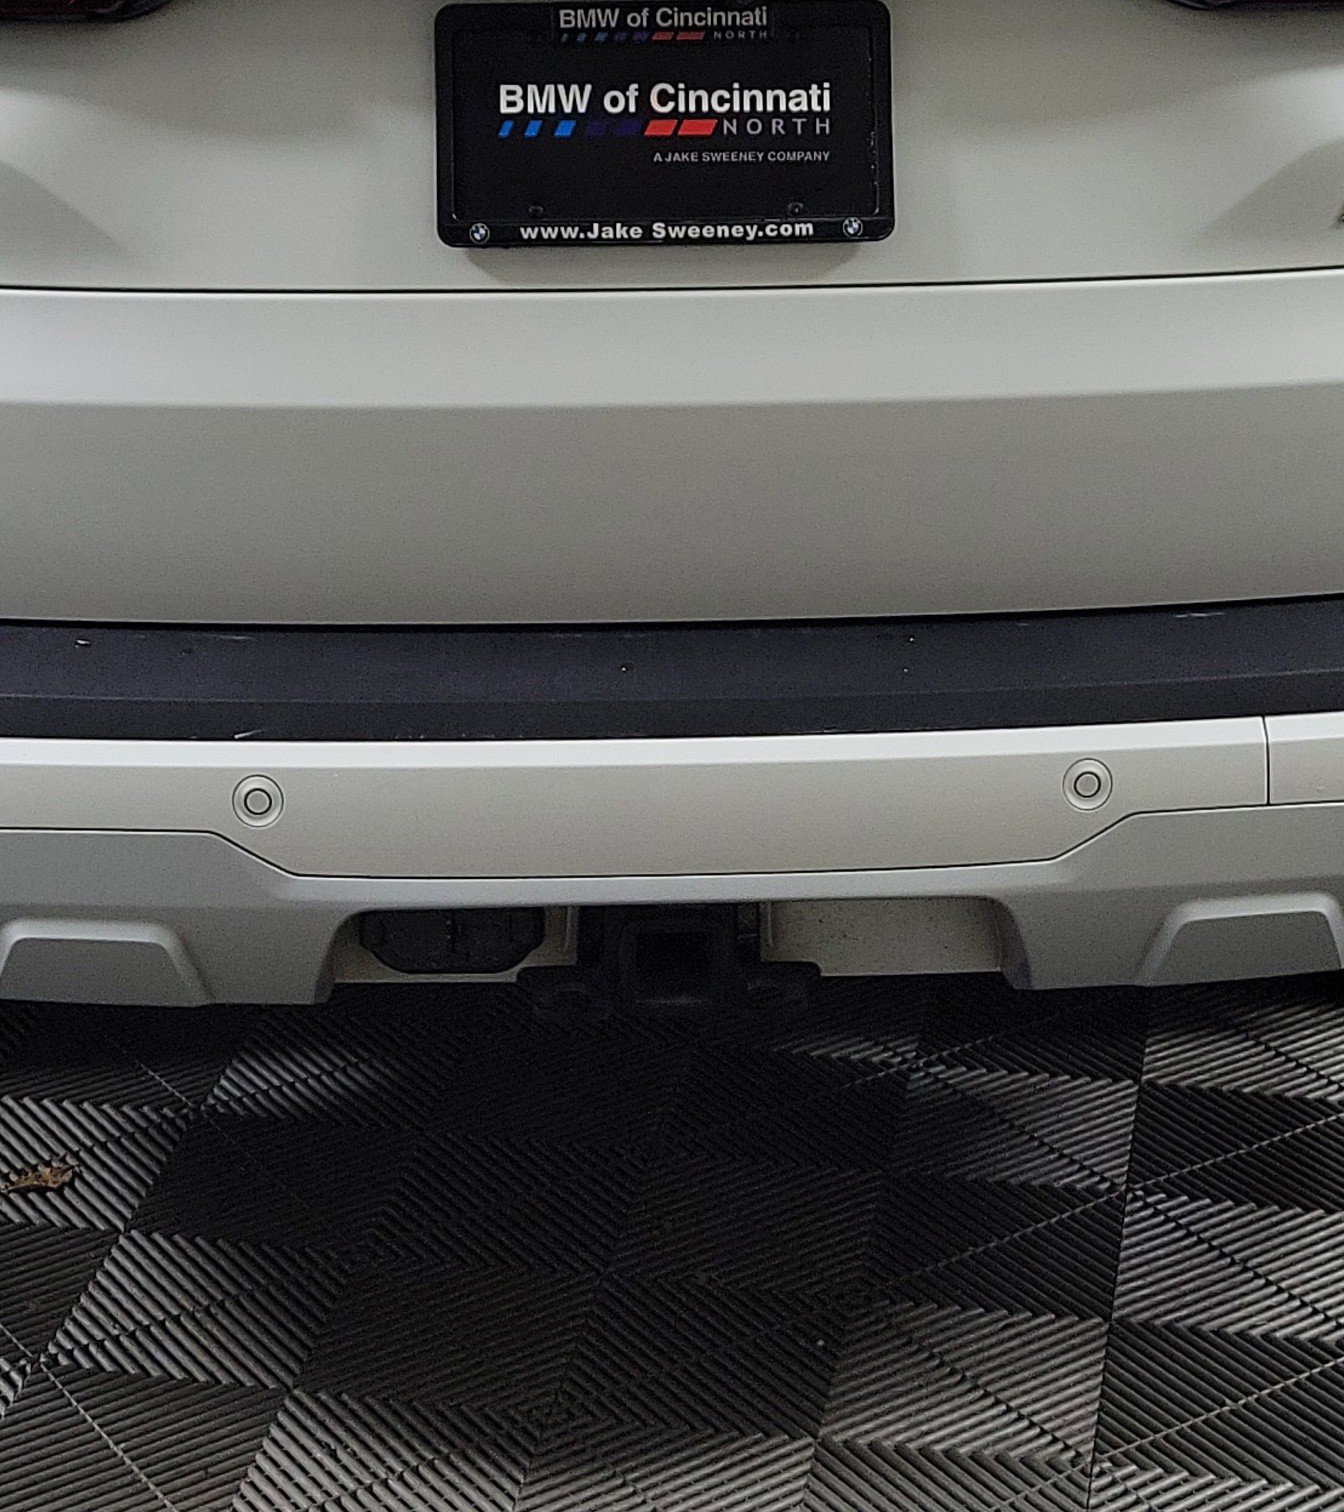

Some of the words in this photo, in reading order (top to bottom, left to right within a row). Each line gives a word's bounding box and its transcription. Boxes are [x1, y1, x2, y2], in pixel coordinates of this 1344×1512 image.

[559, 9, 620, 29] BMW
[627, 8, 650, 28] of
[656, 6, 768, 27] Cincinnati
[714, 30, 768, 40] NORTH
[499, 84, 592, 115] BMW
[603, 84, 640, 114] of
[649, 82, 831, 114] Cincinnati
[723, 118, 831, 136] NORTH
[653, 152, 664, 163] A
[665, 151, 699, 162] JAKE
[702, 151, 764, 162] SWEENEY
[767, 151, 830, 162] COMPANY
[520, 223, 643, 240] www.Jake
[652, 221, 814, 242] Sweeney.com
